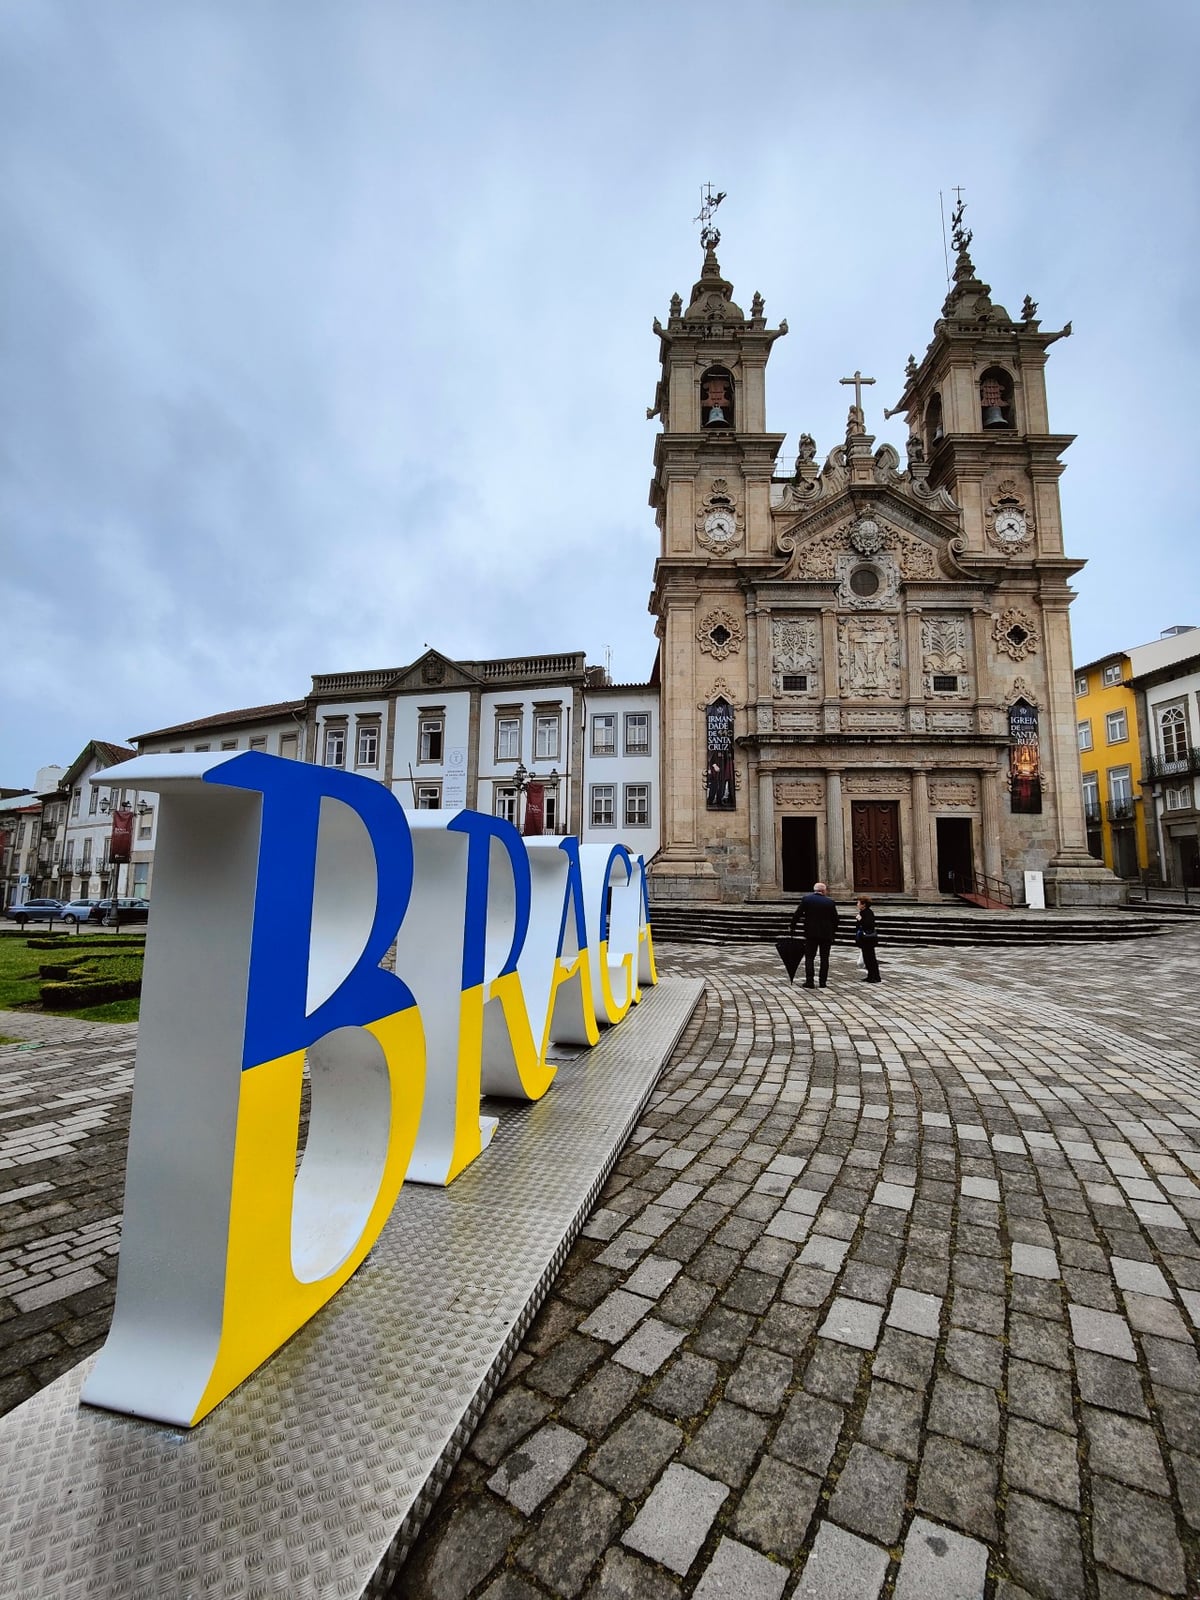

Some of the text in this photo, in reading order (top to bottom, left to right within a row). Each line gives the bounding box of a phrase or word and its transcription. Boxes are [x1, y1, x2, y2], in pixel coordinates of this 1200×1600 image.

[1010, 716, 1038, 725] IGREJA
[708, 722, 728, 730] DADE
[1010, 730, 1037, 739] SANTA
[708, 736, 731, 744] SANTA
[708, 743, 729, 751] CRUZ
[170, 750, 659, 1427] BRAGA
